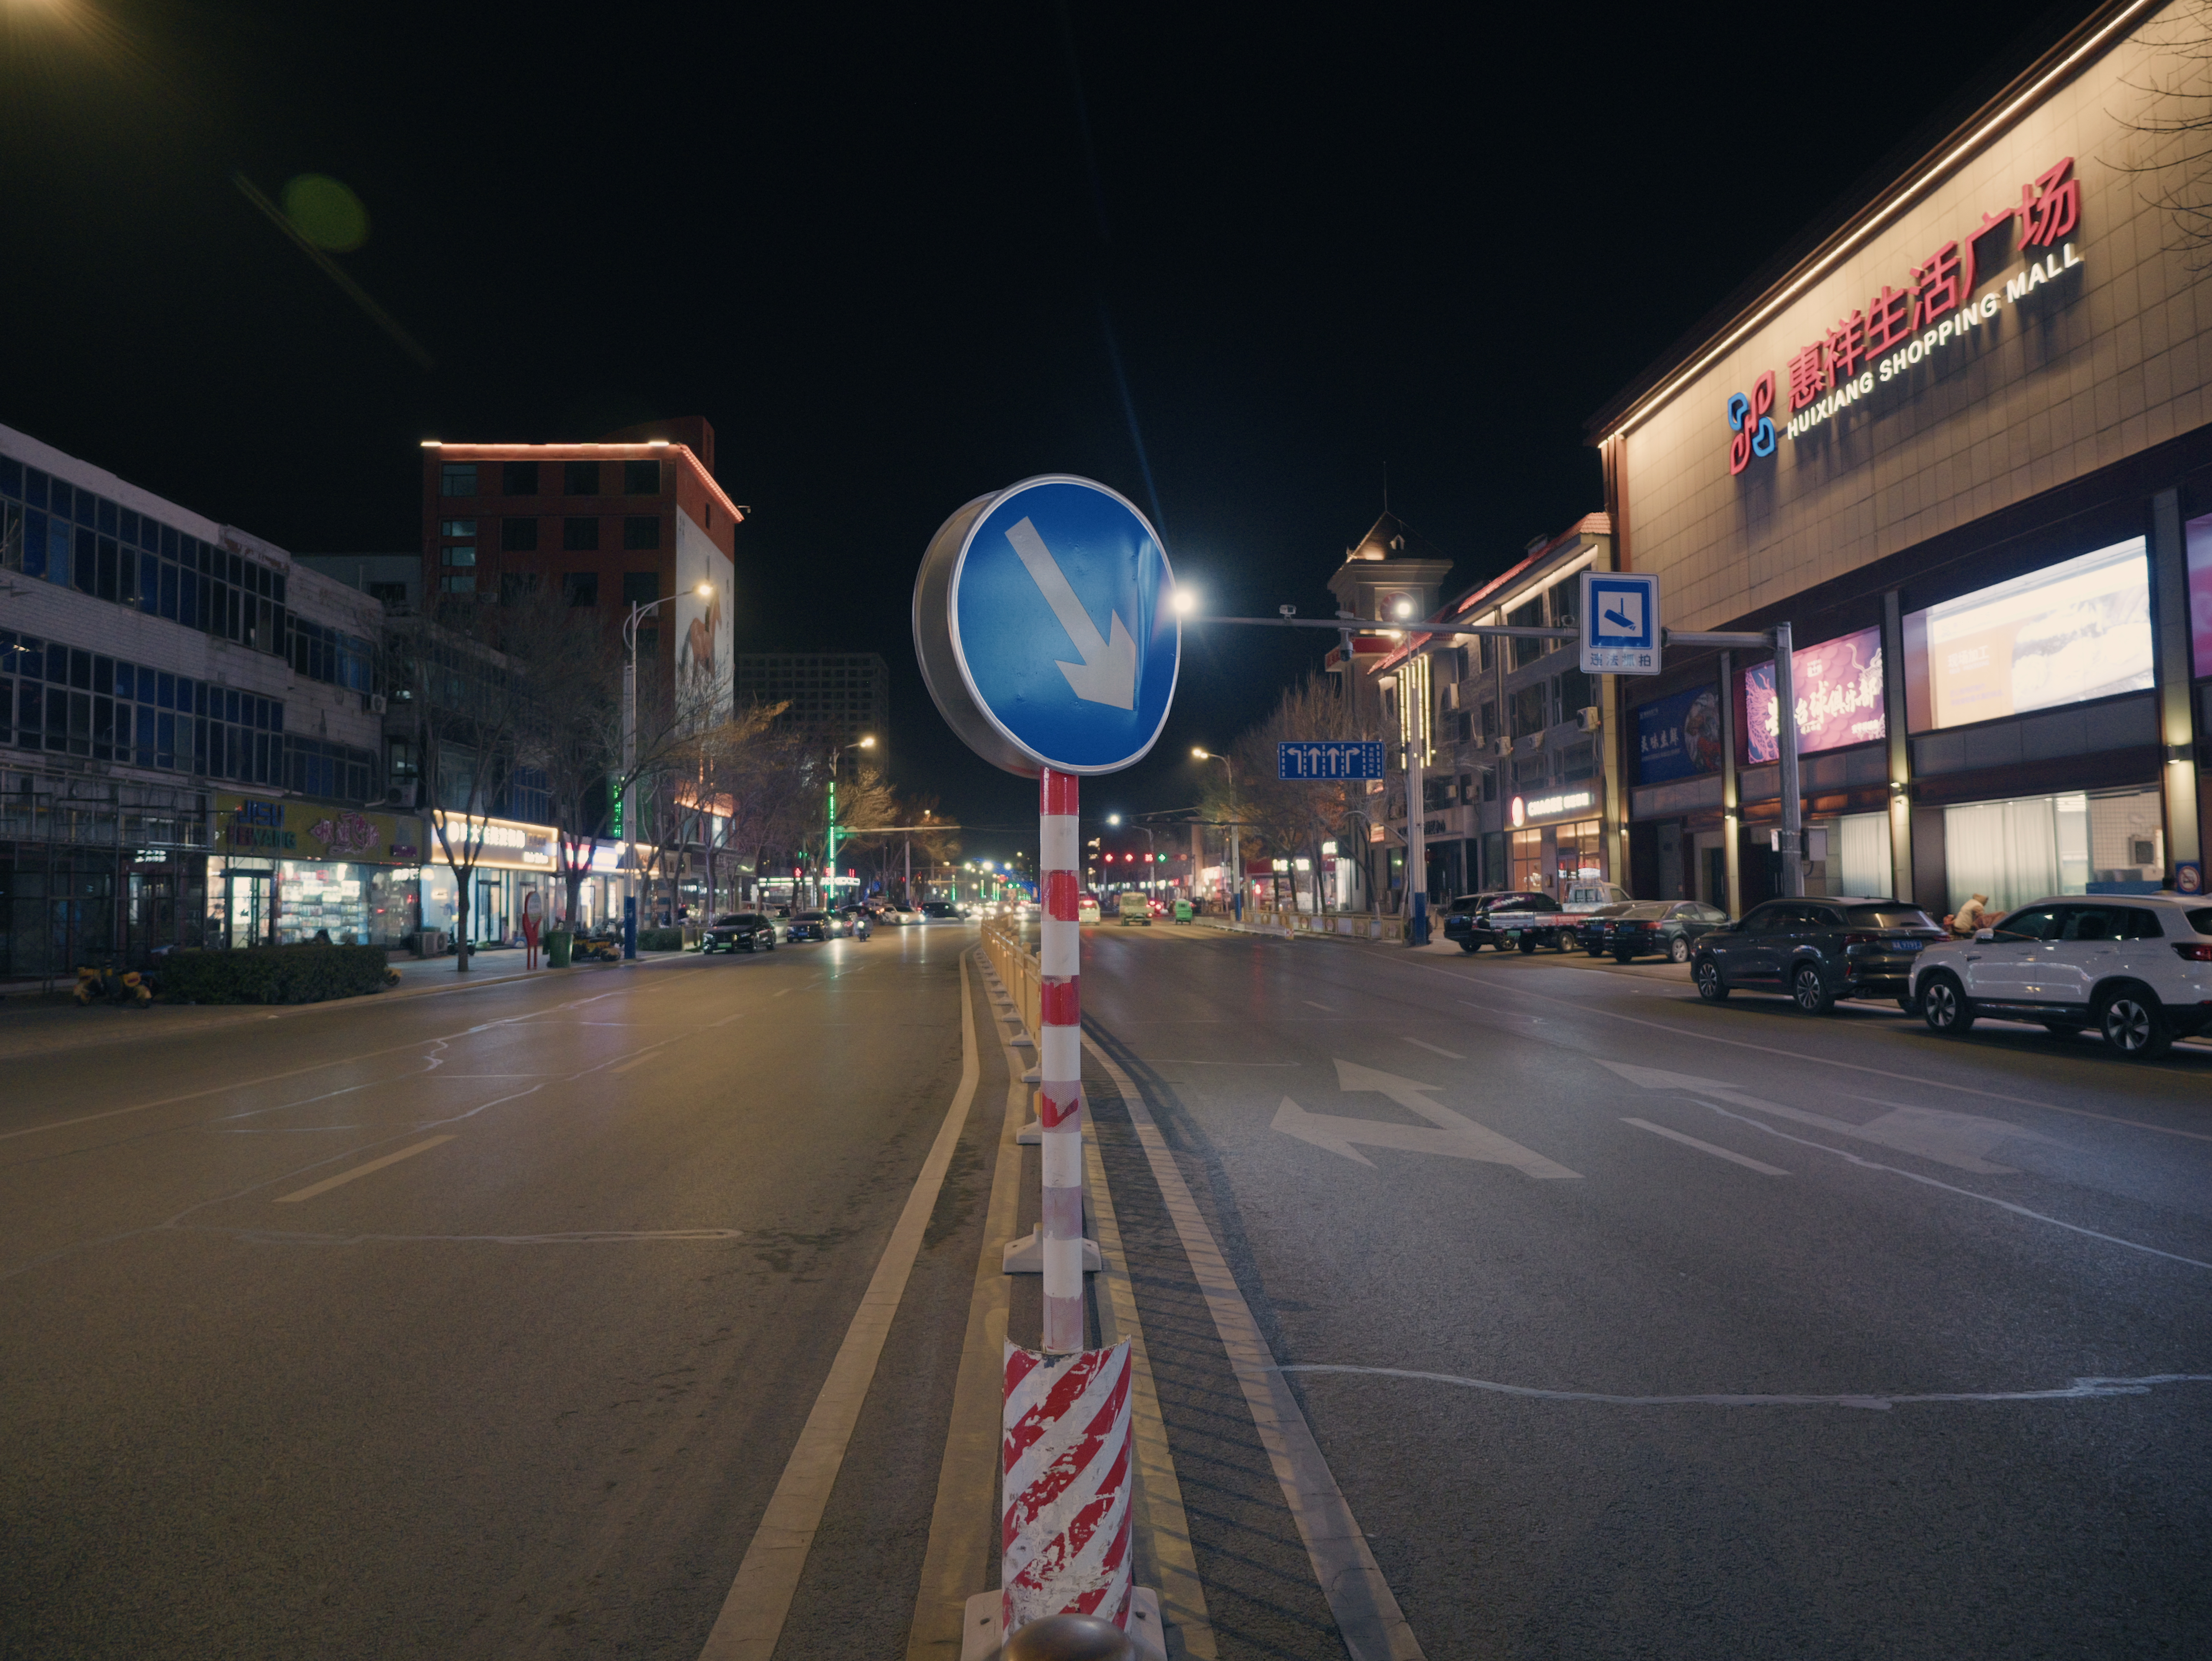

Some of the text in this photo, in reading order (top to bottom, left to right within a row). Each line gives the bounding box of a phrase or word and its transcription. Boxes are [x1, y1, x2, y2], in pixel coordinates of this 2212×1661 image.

[1787, 156, 2081, 413] 惠祥生活广场
[1787, 242, 2081, 440] HUIXIANG SHOPPING MALL
[1590, 653, 1651, 667] 违法抓拍
[1947, 645, 1990, 668] 现场加工
[238, 799, 285, 827] JISU
